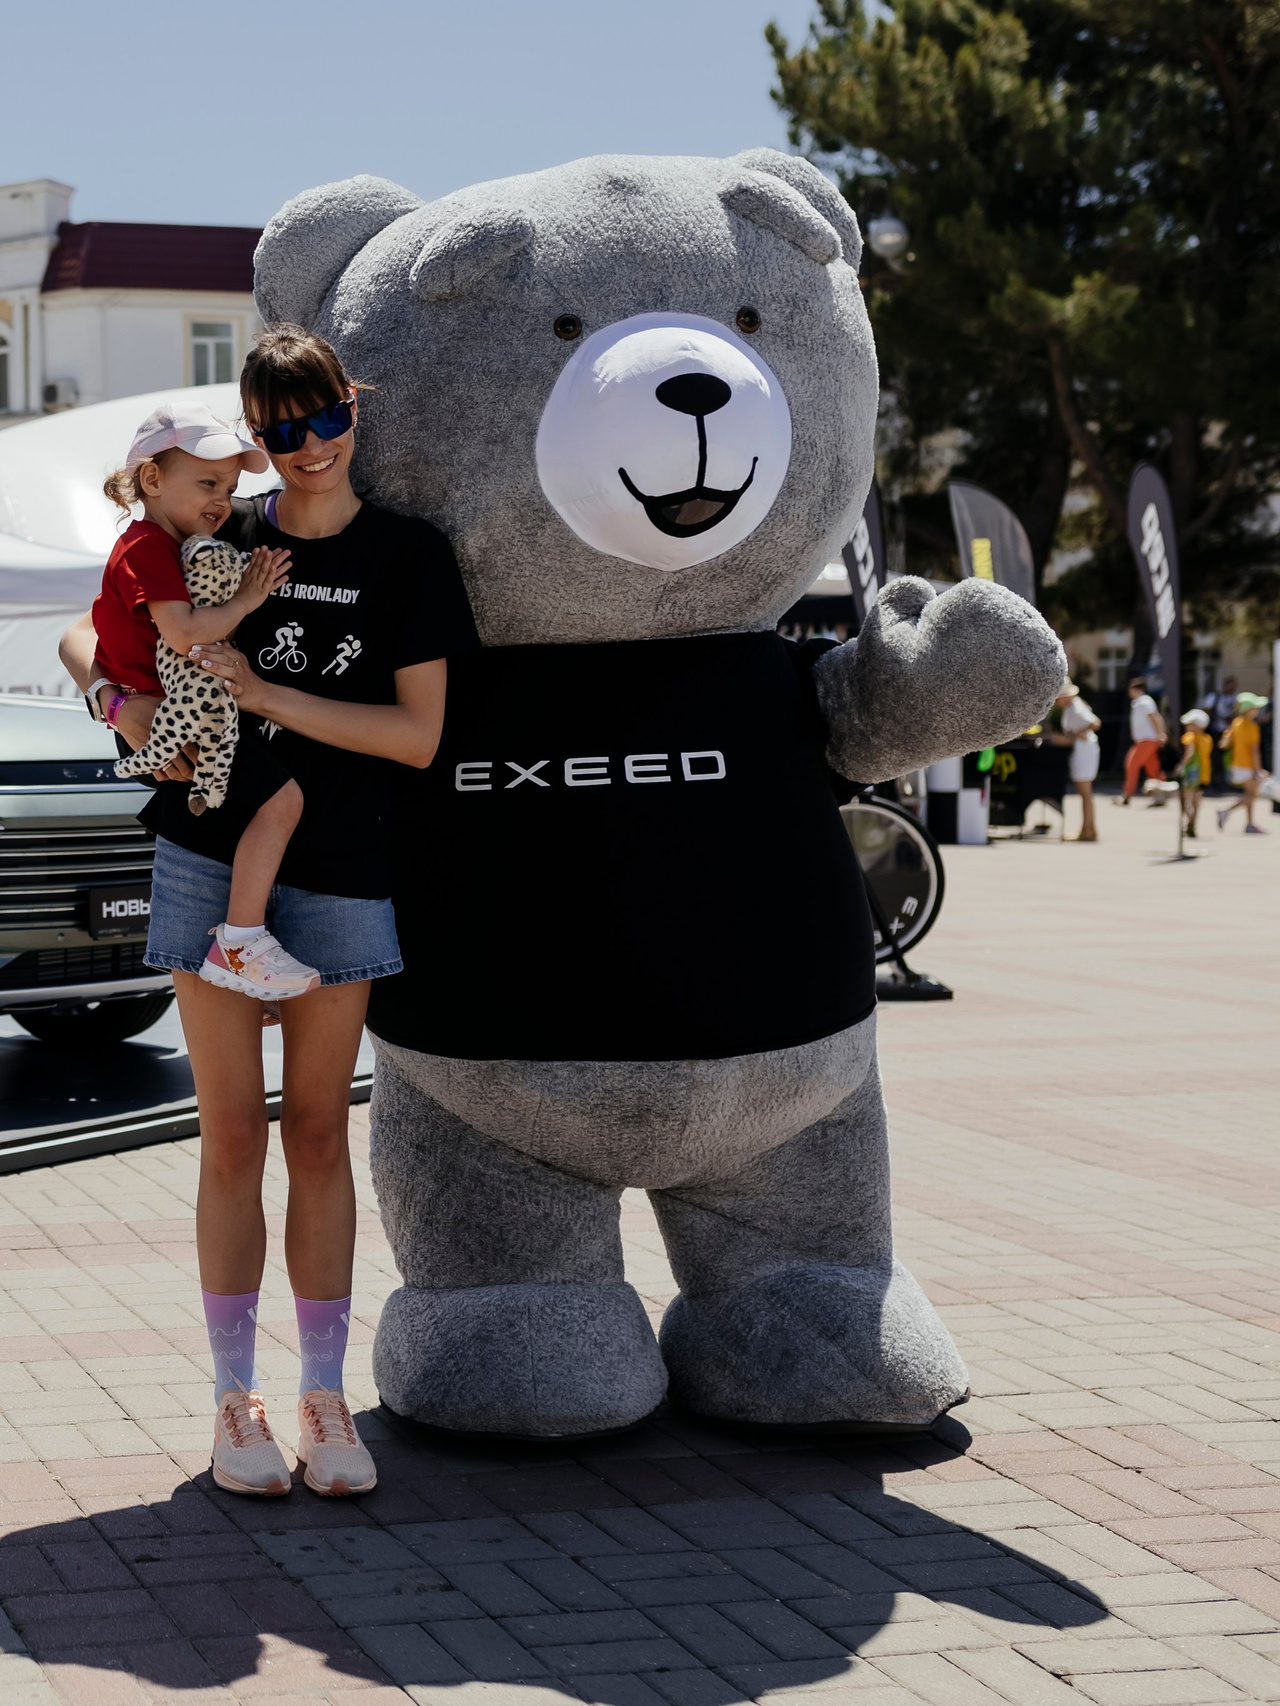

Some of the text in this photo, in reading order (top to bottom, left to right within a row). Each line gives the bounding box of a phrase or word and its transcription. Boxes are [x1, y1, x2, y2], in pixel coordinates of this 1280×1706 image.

[280, 583, 292, 597] IS
[294, 584, 360, 604] IRONLADY
[455, 750, 726, 791] EXEED
